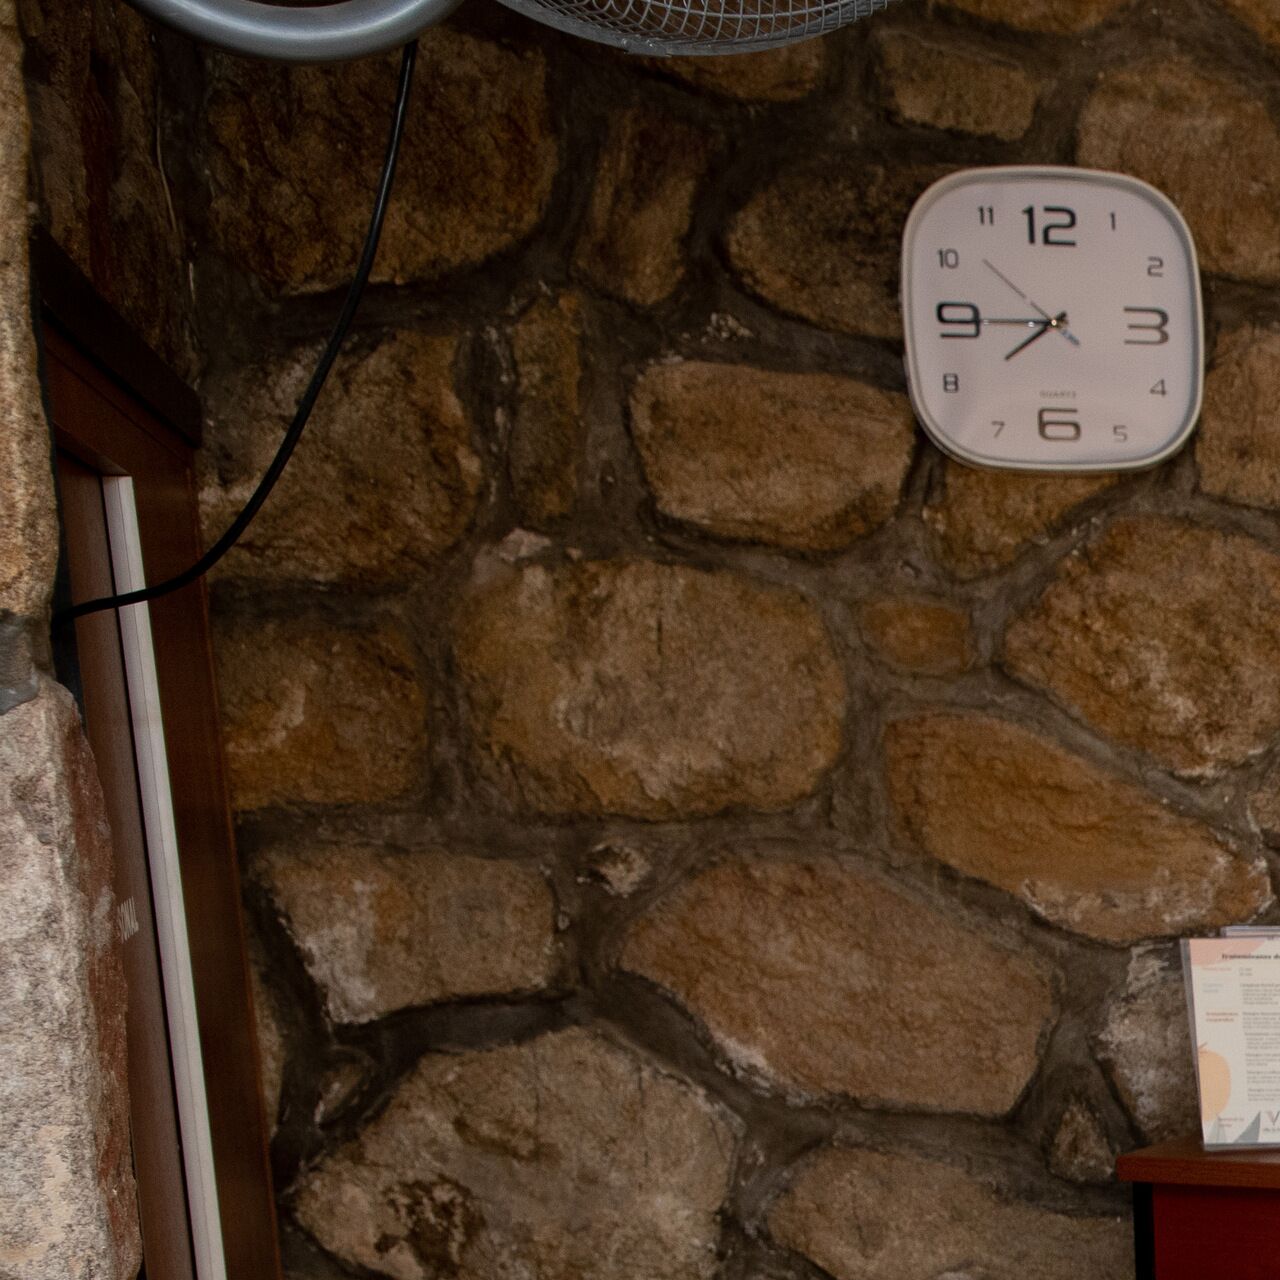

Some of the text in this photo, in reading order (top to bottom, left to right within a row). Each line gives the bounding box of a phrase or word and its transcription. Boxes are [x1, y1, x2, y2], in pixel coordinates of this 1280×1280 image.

[978, 206, 994, 225] 11
[1109, 212, 1116, 231] 1
[1022, 205, 1077, 247] 12
[937, 248, 959, 269] 10
[1146, 256, 1164, 278] 2
[935, 301, 981, 339] 9
[1123, 307, 1170, 345] 3
[942, 373, 960, 393] 8
[1149, 378, 1167, 397] 4
[991, 420, 1006, 438] 7
[1037, 407, 1082, 441] 6
[1112, 424, 1128, 441] 5
